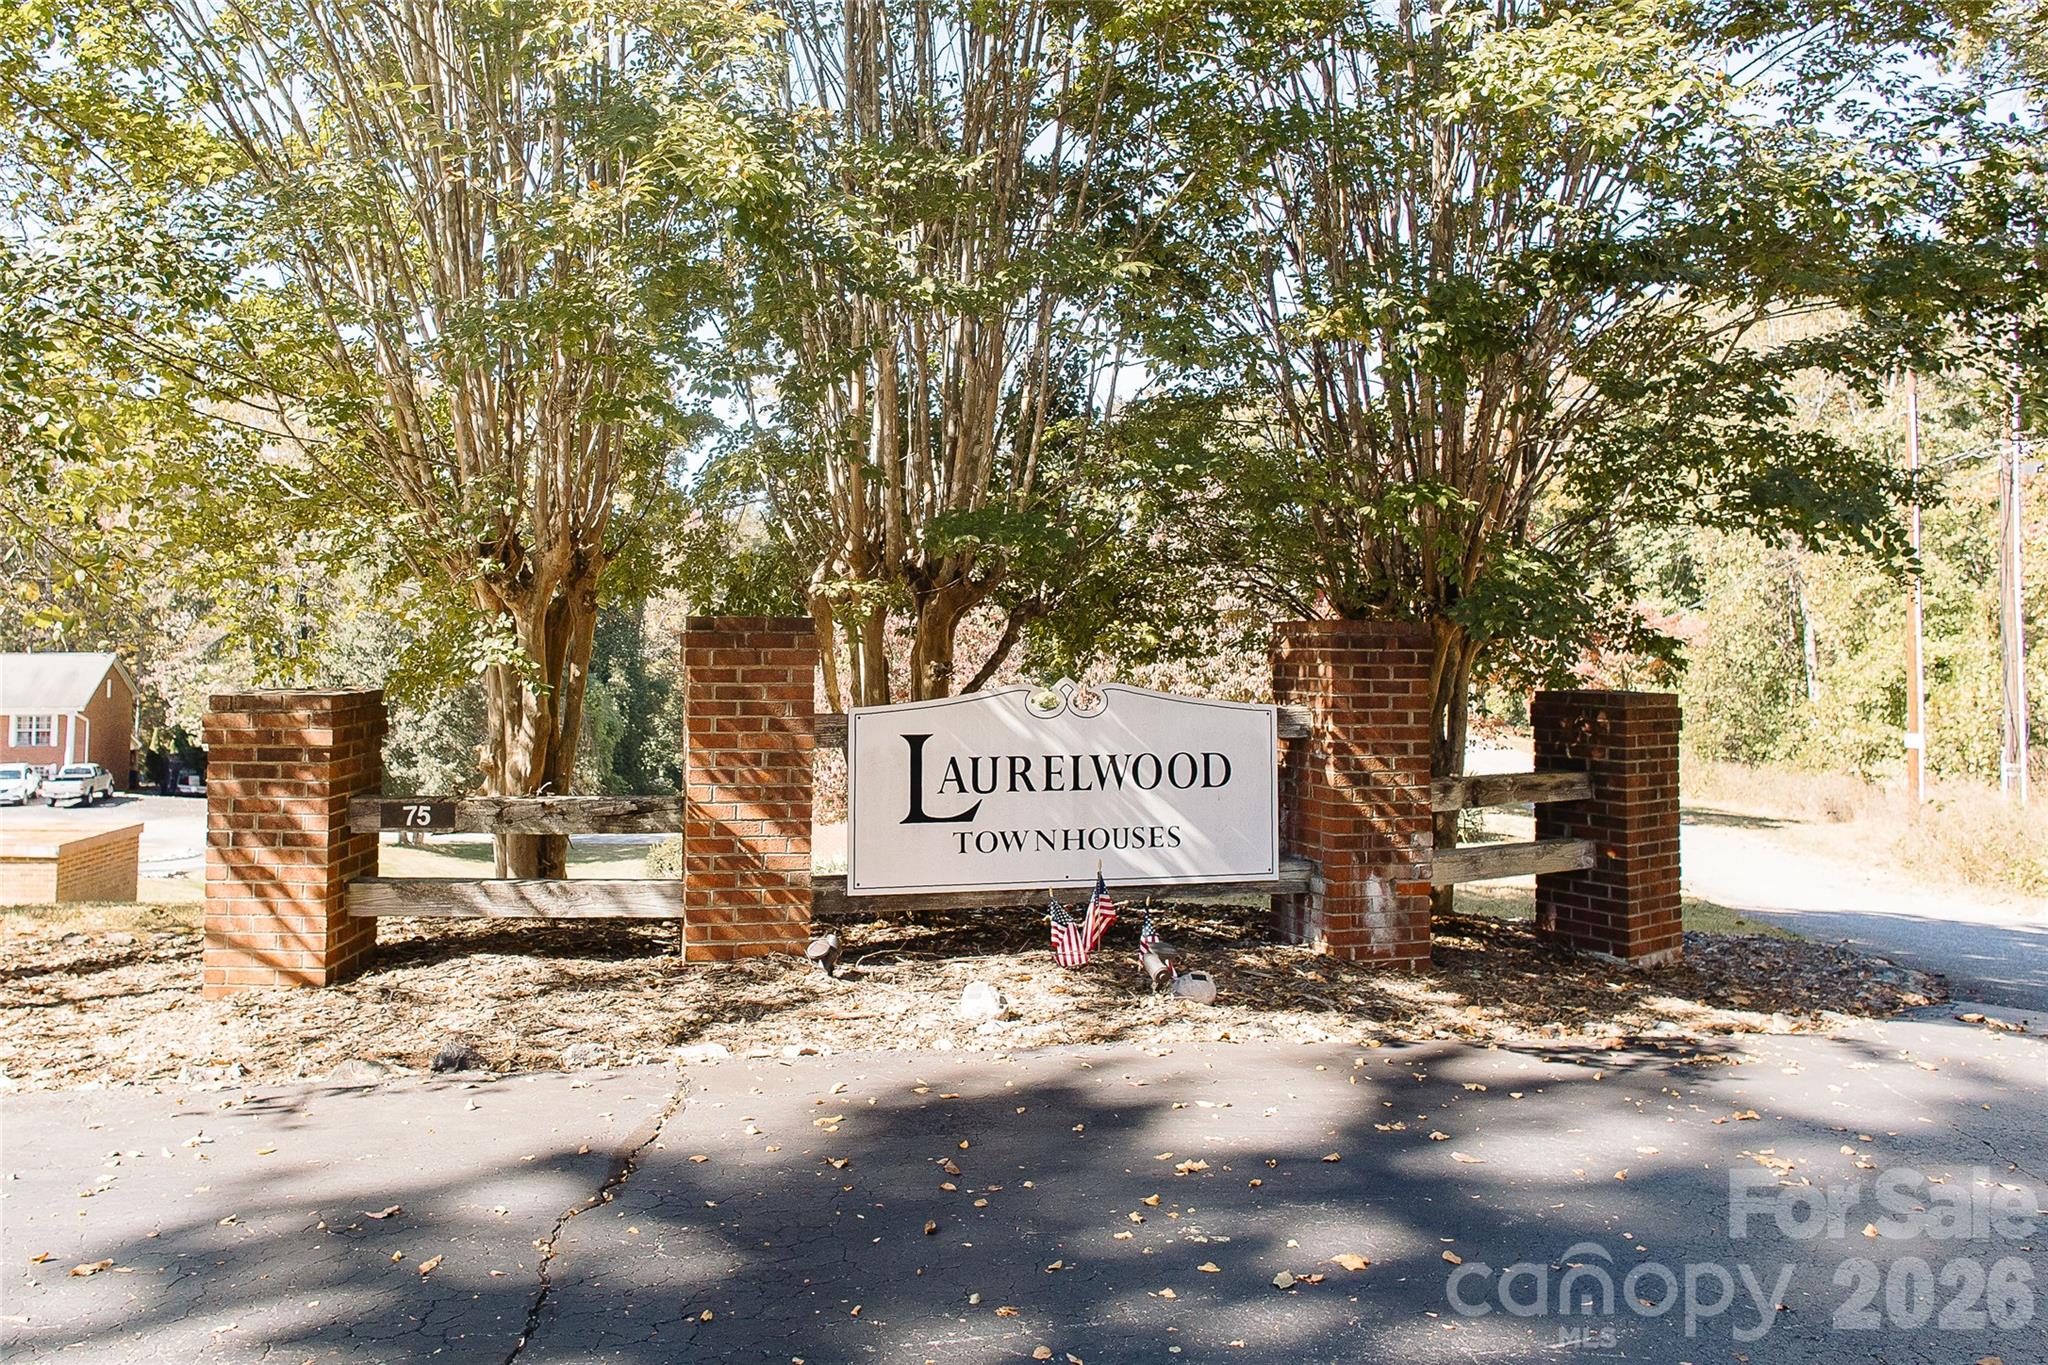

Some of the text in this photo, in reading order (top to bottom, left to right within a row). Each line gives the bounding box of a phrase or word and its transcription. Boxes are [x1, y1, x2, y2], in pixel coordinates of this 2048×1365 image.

[899, 733, 1232, 824] LAURELWOOD
[402, 805, 431, 826] 75
[953, 825, 1181, 854] TOWNHOUSES
